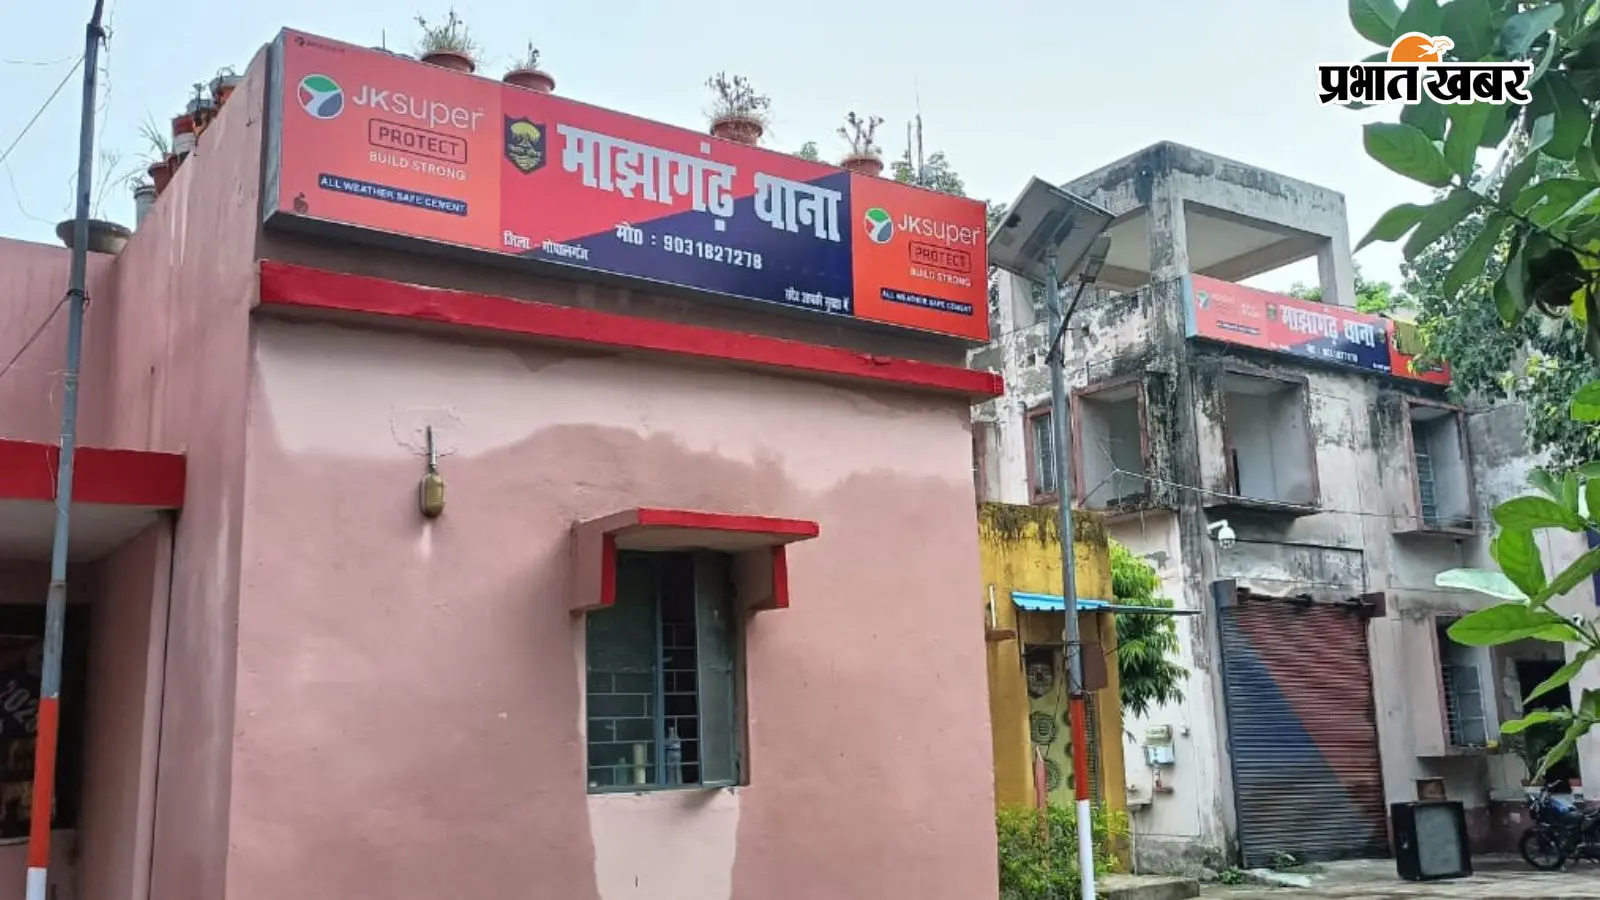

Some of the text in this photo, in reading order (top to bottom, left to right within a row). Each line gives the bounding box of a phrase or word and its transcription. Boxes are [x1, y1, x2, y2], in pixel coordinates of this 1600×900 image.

[379, 126, 460, 157] PROTECT
[369, 151, 467, 181] BUILD STRONG
[321, 177, 466, 213] ALL WEATHER SAFE CEMENT
[556, 123, 842, 243] माझागंढ़ थाना
[664, 234, 762, 270] 9031827278
[915, 247, 966, 267] PROTECT
[910, 267, 972, 287] BUILD STRONG
